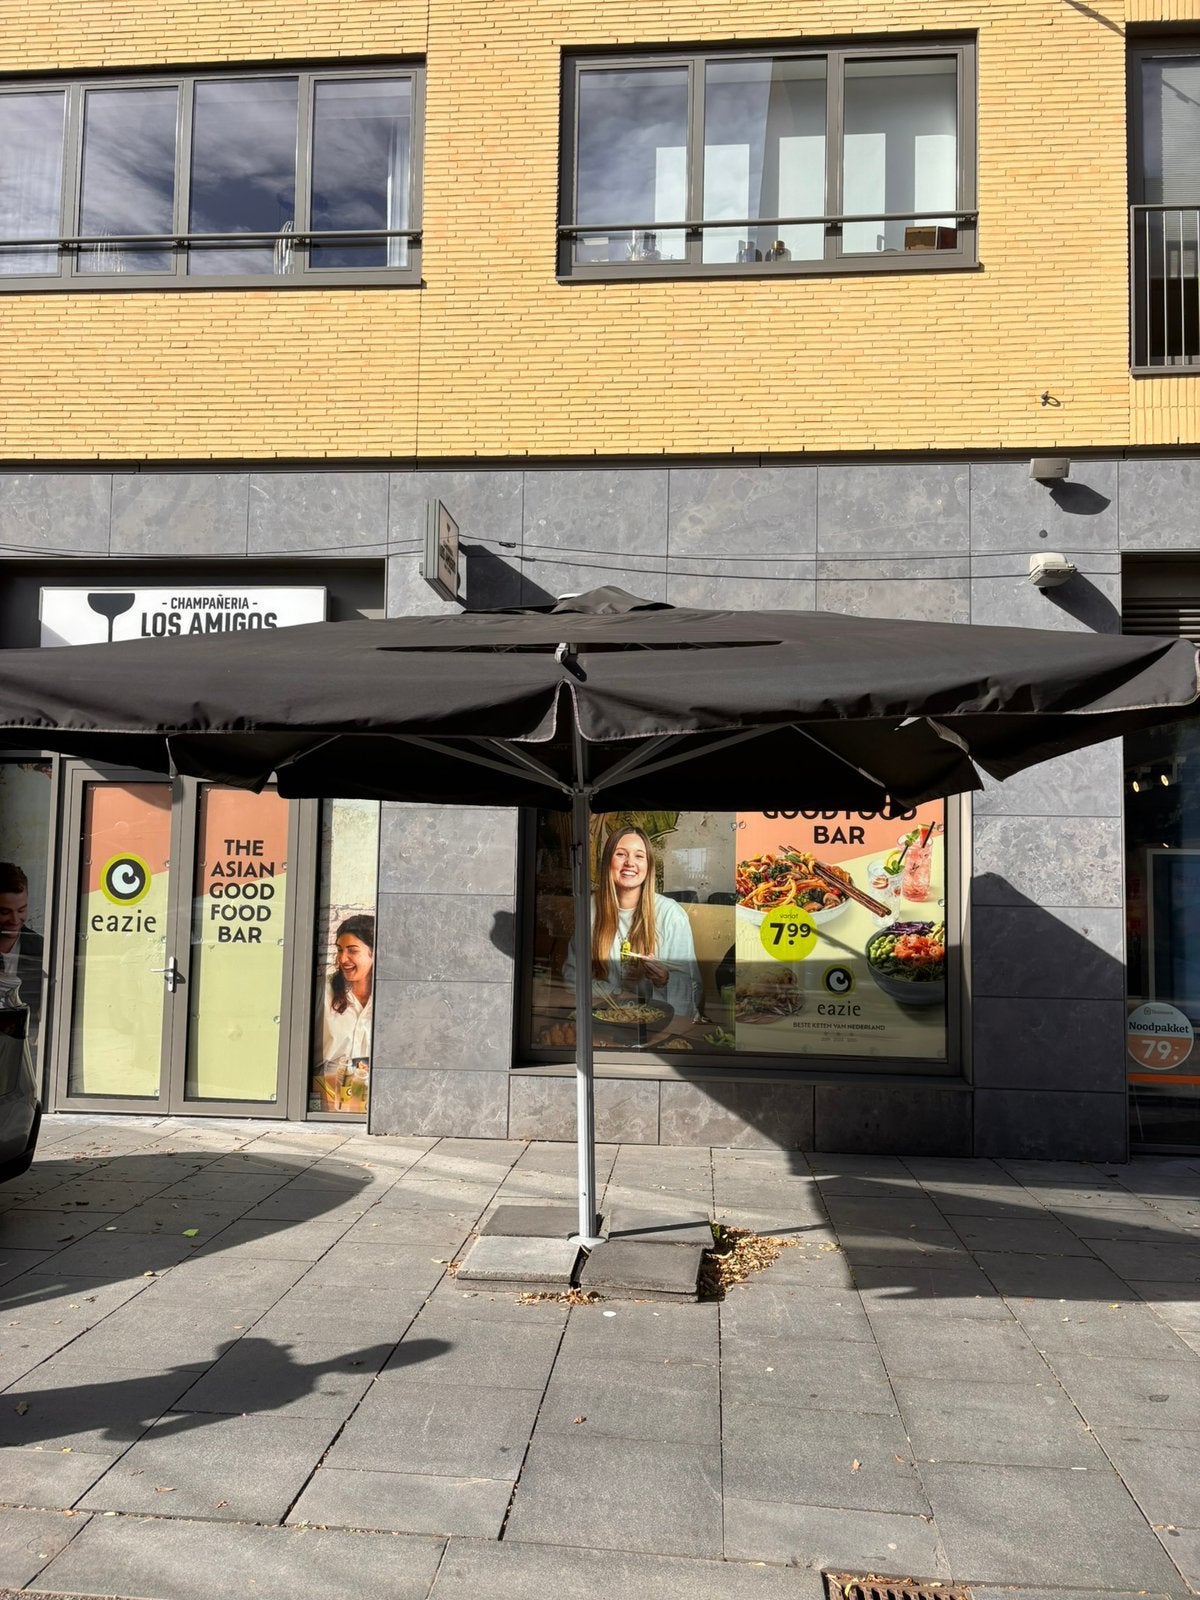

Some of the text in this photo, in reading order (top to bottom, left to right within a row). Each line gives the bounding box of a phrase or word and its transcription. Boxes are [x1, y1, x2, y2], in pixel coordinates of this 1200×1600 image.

[171, 594, 249, 609] CHAMPAÑERIA
[141, 612, 277, 637] LOS AMIGOS
[813, 826, 865, 844] BAR
[224, 839, 264, 856] THE
[210, 861, 275, 878] ASIAN
[209, 882, 275, 900] GOOD
[91, 909, 157, 933] eazie
[210, 904, 272, 922] FOOD
[218, 926, 262, 943] BAR
[817, 1001, 861, 1016] eazie
[1128, 1022, 1190, 1033] Noodpakket
